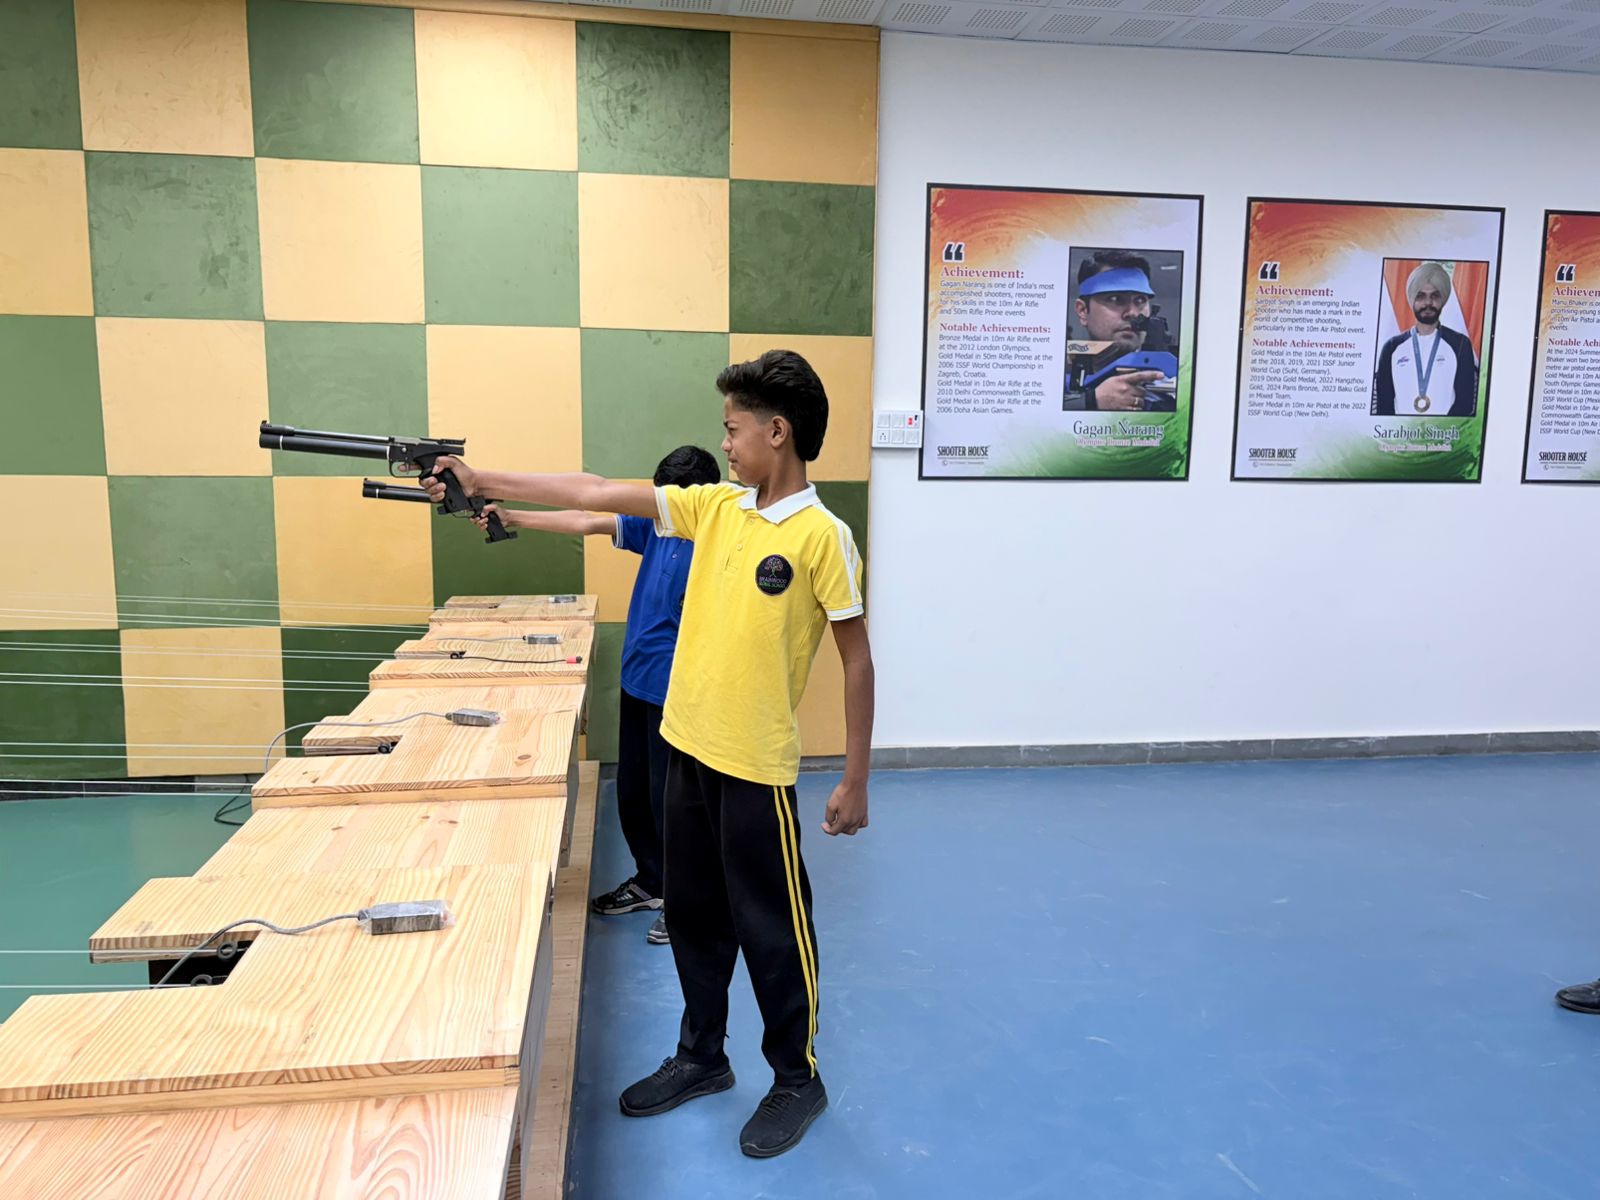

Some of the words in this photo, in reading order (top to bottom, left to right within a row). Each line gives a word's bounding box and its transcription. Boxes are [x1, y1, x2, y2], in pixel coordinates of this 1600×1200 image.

[942, 267, 1024, 278] Achievement:
[962, 281, 986, 289] Narang
[1014, 291, 1046, 299] renowned
[1257, 285, 1333, 296] Achievement:
[1312, 299, 1340, 308] emerging
[1280, 316, 1314, 324] competitive
[940, 323, 978, 332] Notable
[980, 324, 1050, 333] Achievements:
[1253, 338, 1288, 347] Notable
[1290, 339, 1355, 349] Achievements:
[1549, 338, 1581, 346] Notable
[992, 362, 1036, 370] Championship
[1294, 410, 1310, 418] (New
[1073, 420, 1112, 438] Gagan
[1117, 420, 1164, 439] Narang
[1374, 424, 1420, 440] Sarabjot
[1426, 425, 1459, 442] Singh
[937, 446, 966, 456] SHOOTER
[968, 446, 988, 456] HOUSE
[1249, 448, 1275, 458] SHOOTER
[1277, 448, 1296, 458] HOUSE
[1539, 452, 1566, 461] SHOOTER
[1568, 452, 1587, 461] HOUSE
